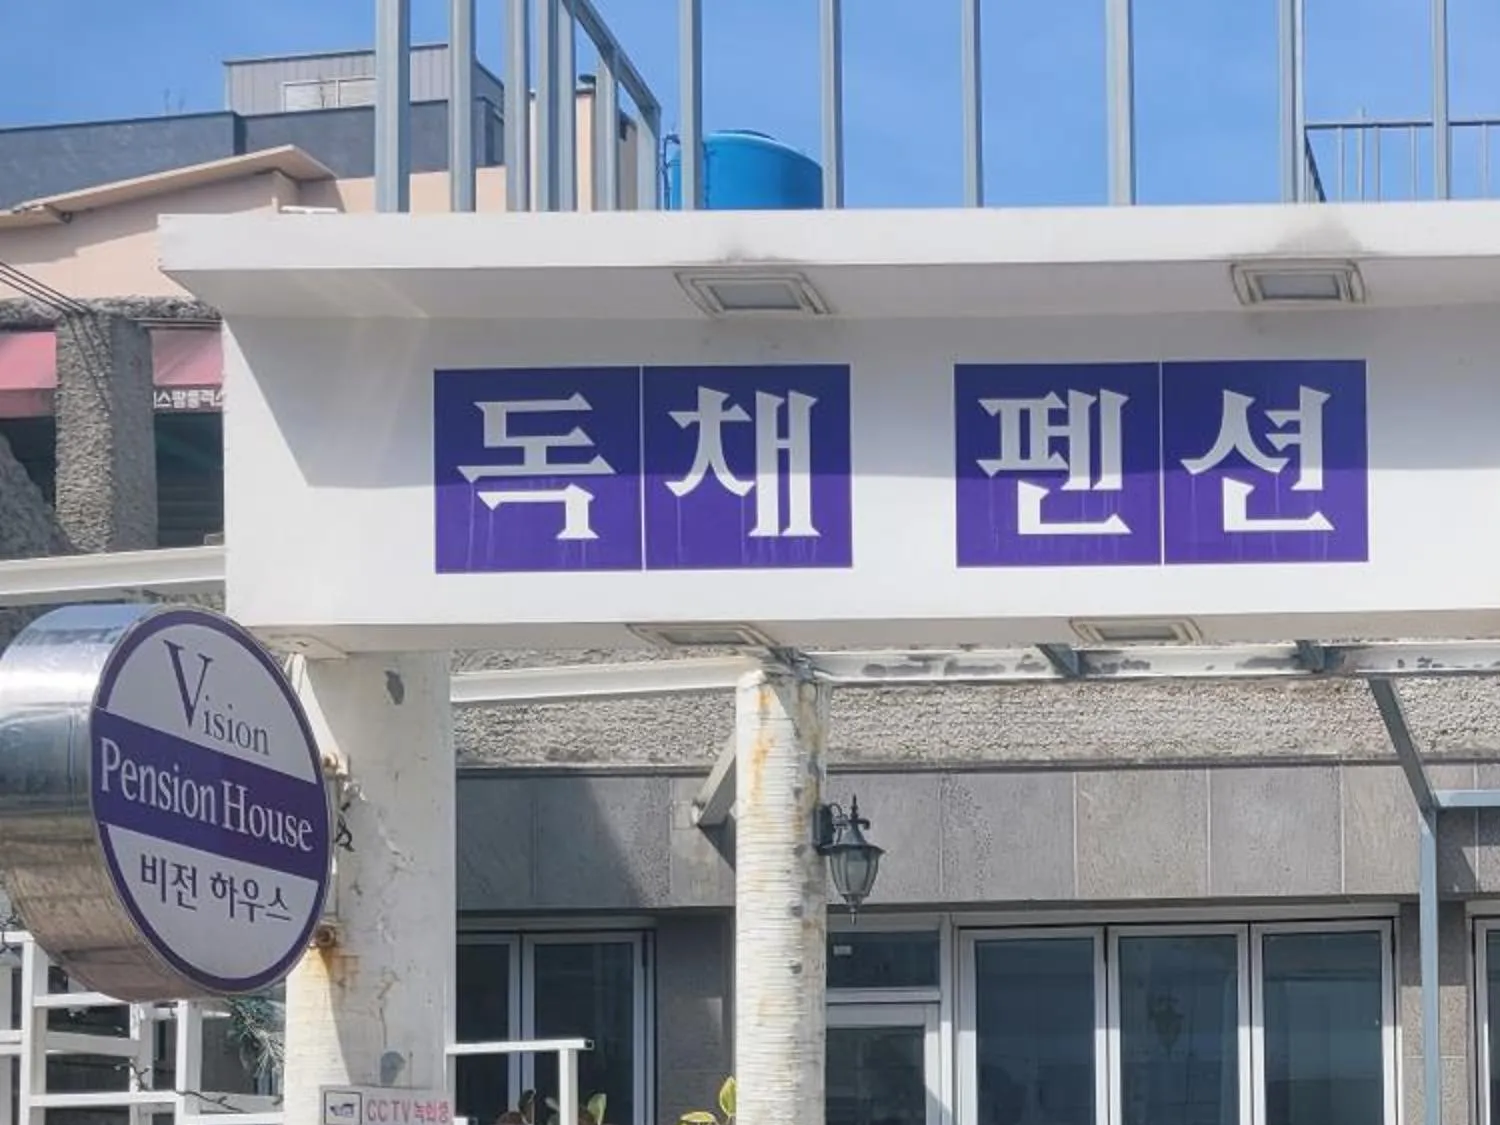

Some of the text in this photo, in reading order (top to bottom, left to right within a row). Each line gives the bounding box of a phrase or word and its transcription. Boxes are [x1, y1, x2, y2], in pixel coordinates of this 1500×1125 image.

[456, 385, 822, 540] 독채
[976, 383, 1336, 537] 펜션
[162, 638, 271, 757] Vision
[100, 736, 314, 853] Pension House
[139, 852, 293, 923] 비전 하우스
